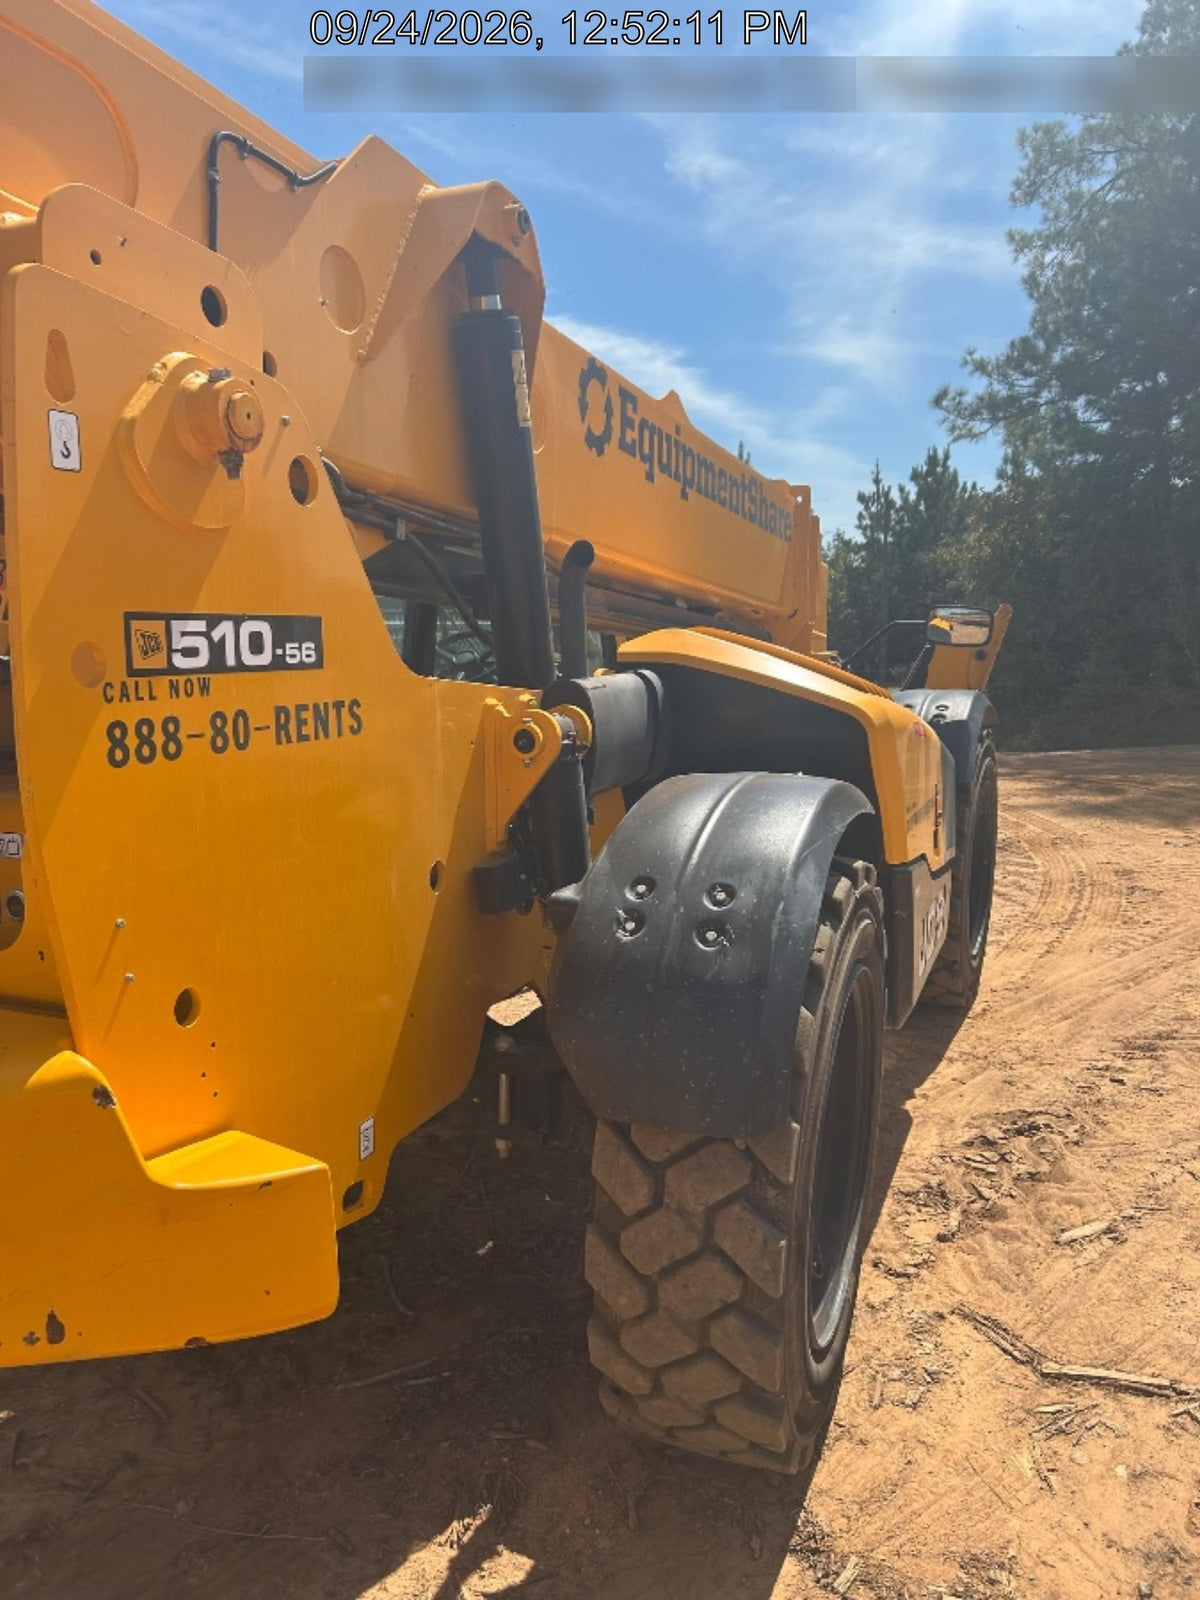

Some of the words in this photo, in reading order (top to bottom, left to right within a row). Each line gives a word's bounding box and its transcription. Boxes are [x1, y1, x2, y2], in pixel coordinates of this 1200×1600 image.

[618, 384, 792, 542] EquipmentShare
[102, 681, 158, 704] CALL
[169, 677, 212, 699] NOW
[106, 698, 364, 769] 888-80-RENTS
